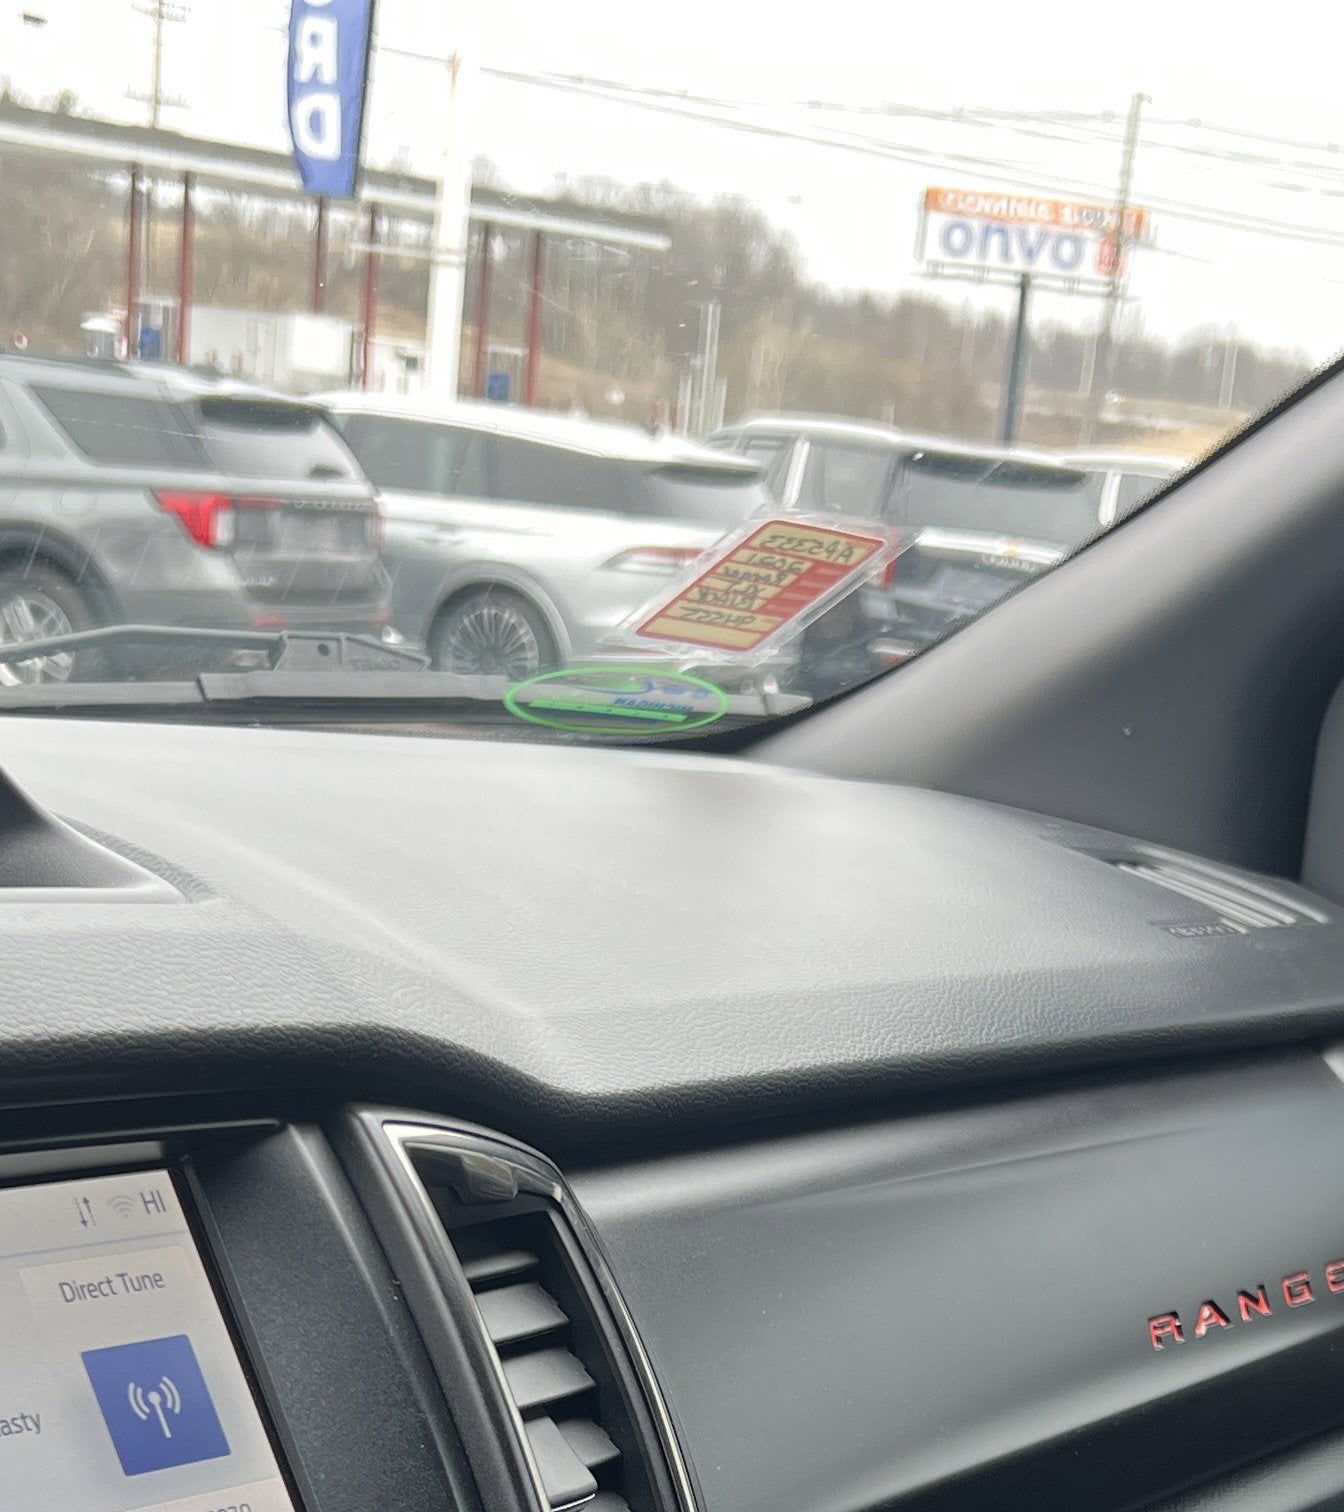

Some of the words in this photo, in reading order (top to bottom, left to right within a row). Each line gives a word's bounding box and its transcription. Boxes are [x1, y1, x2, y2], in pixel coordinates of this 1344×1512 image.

[941, 220, 1086, 270] onvo
[139, 1190, 167, 1215] HI
[59, 1276, 117, 1304] Direct
[115, 1272, 165, 1294] Tune
